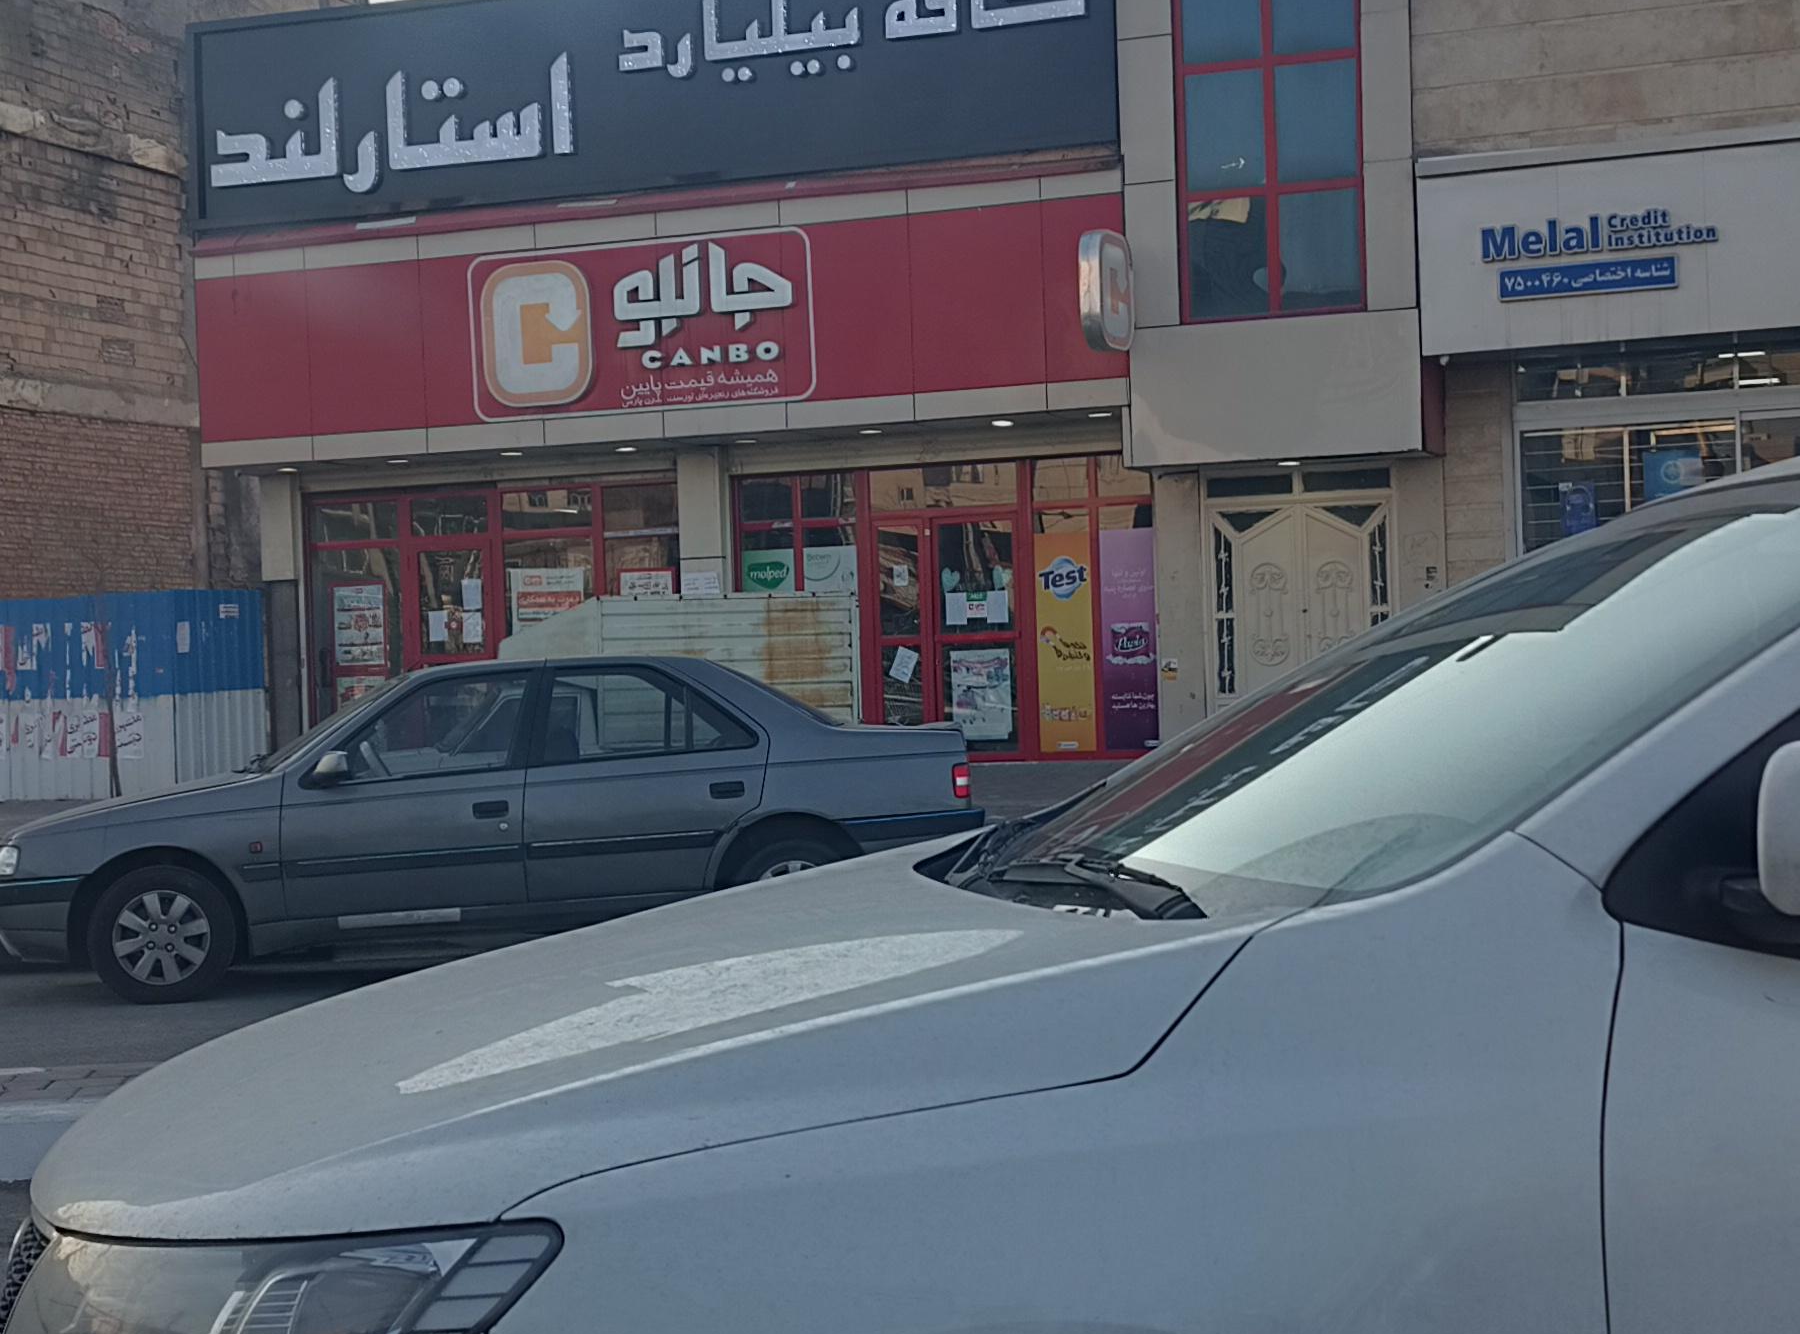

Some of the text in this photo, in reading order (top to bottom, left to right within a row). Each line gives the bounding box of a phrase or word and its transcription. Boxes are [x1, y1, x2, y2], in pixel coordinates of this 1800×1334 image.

[209, 50, 574, 194] استارلند
[1608, 208, 1669, 230] Credit
[1481, 214, 1601, 261] Melal
[1608, 225, 1718, 249] Institution
[1571, 264, 1632, 288] اختصاصی
[1634, 262, 1671, 278] شناسه
[612, 241, 793, 348] جانبو
[641, 340, 780, 370] CANBO
[620, 368, 778, 400] همیشه قیمت پایین
[750, 564, 787, 581] molped
[1038, 565, 1088, 591] Test
